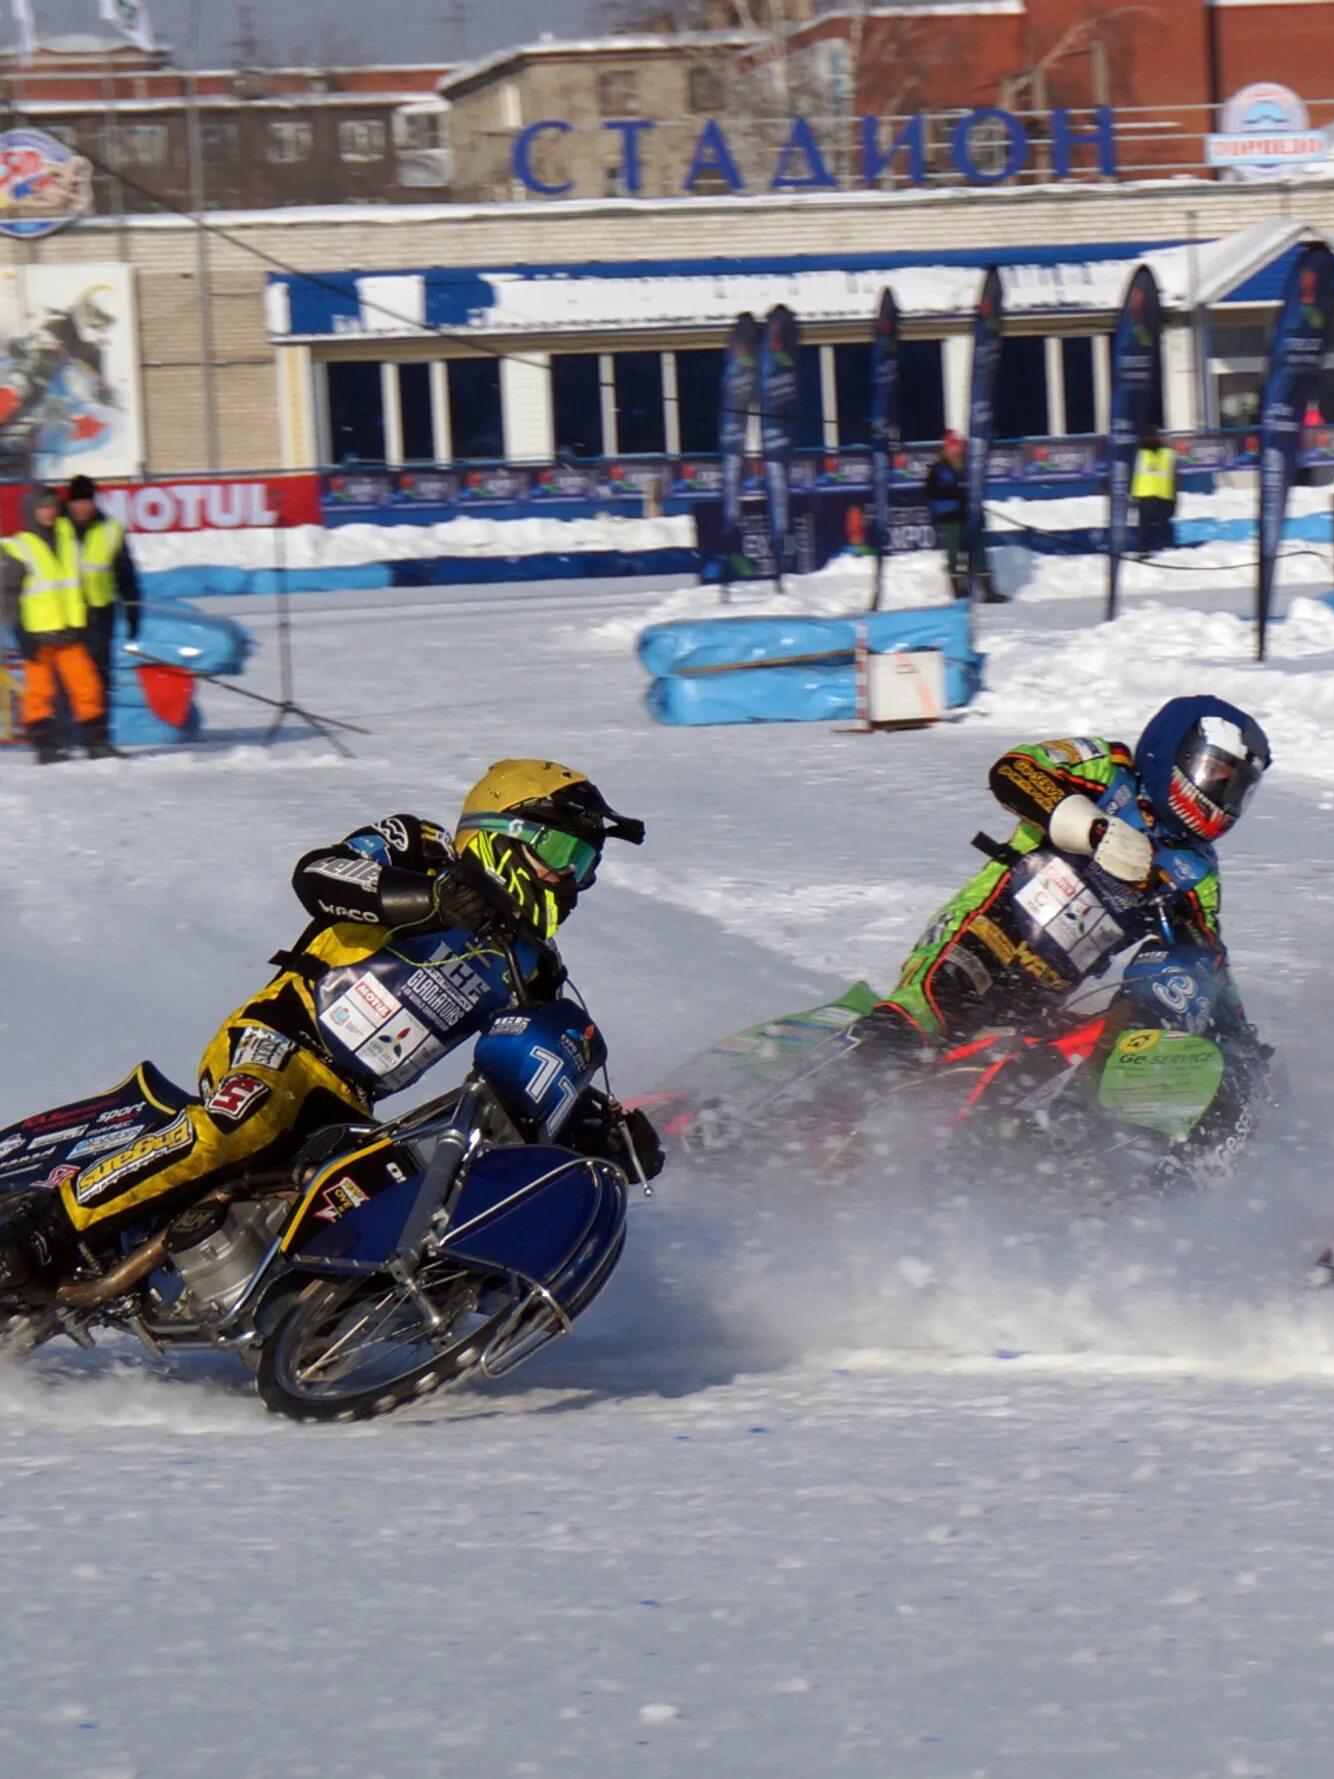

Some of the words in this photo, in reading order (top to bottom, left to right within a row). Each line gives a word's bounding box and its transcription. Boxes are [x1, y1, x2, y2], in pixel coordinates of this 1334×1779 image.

[511, 106, 1117, 196] СТАДИОН
[318, 899, 380, 923] WACO
[426, 940, 492, 1004] ICE
[355, 983, 390, 1016] MOTUL
[97, 1101, 147, 1124] sport
